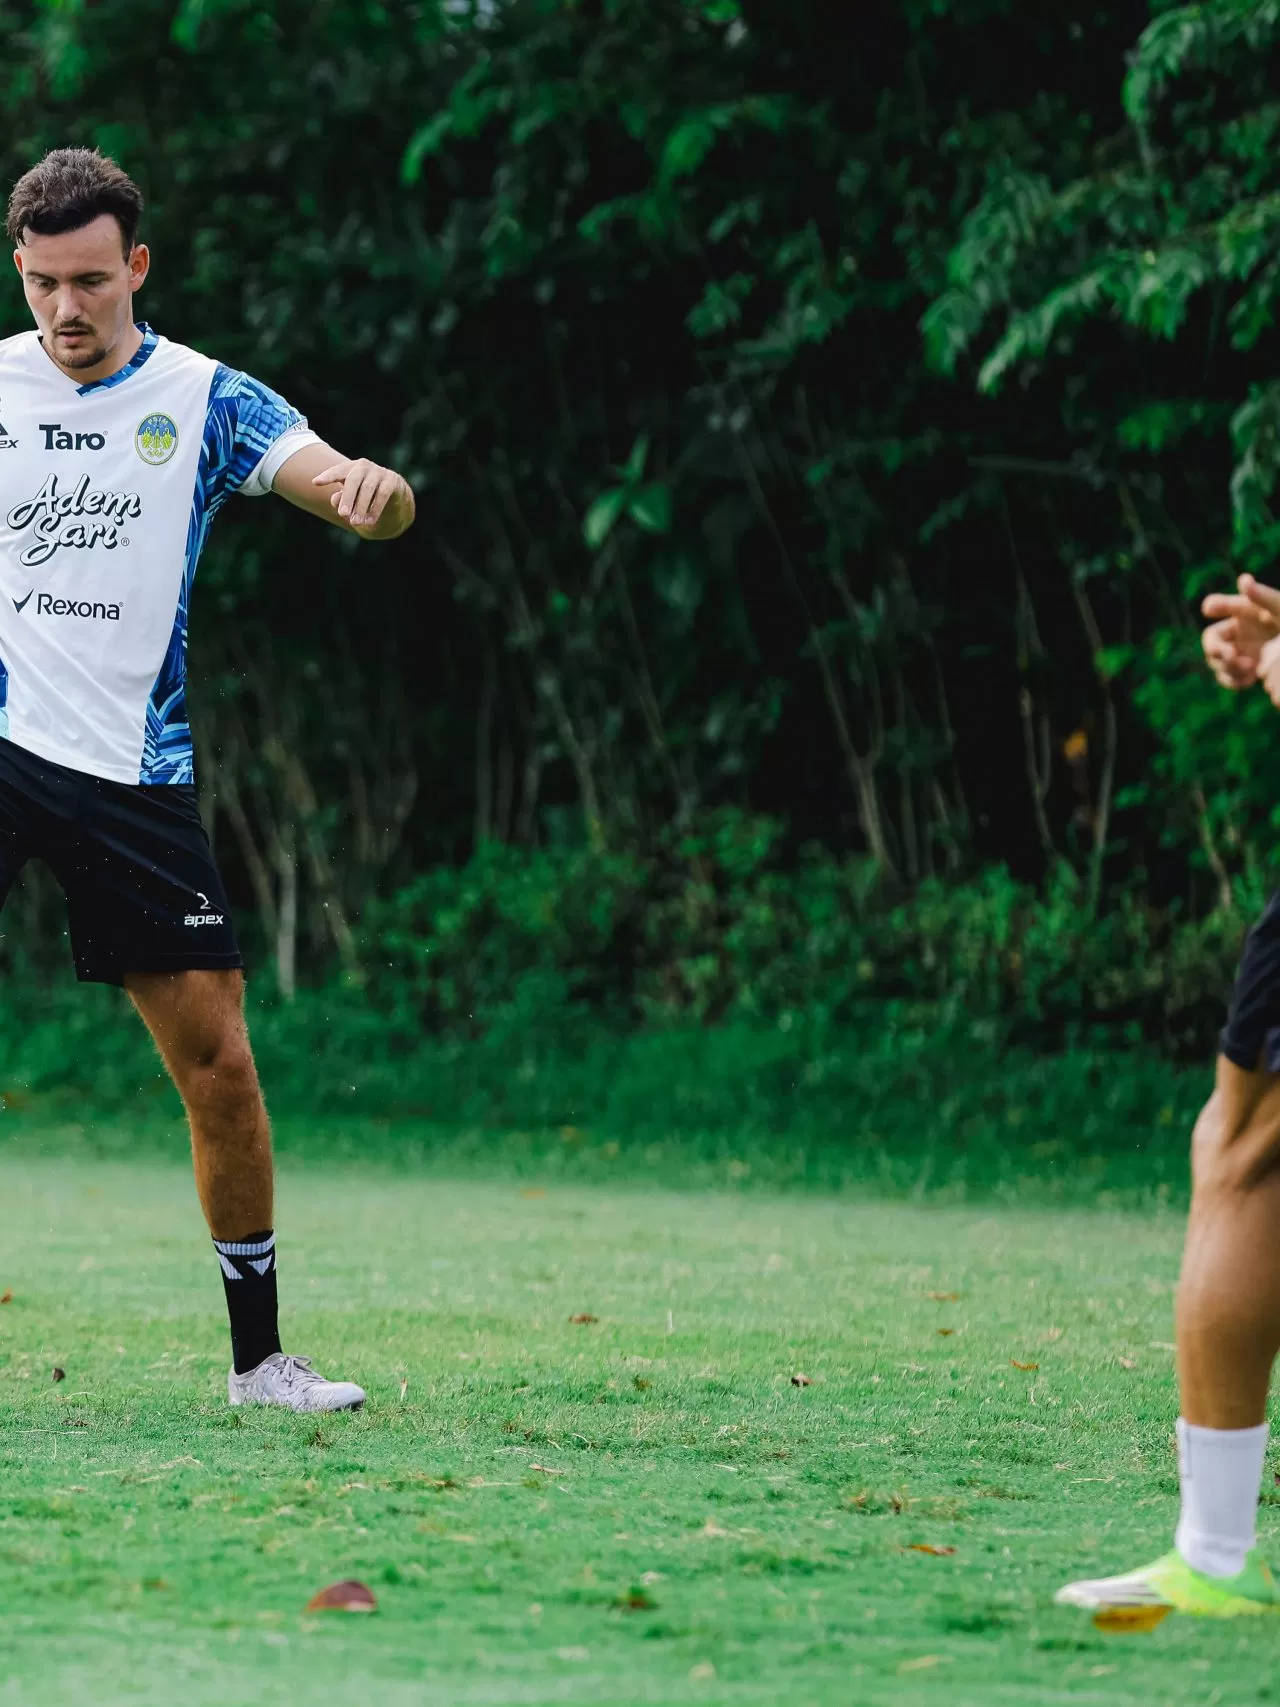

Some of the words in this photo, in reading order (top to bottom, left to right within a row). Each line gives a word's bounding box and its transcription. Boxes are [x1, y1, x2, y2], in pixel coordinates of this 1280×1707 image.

[39, 424, 106, 450] Taro
[7, 472, 141, 530] Adem
[20, 511, 124, 566] Sari
[37, 593, 120, 620] Rexona
[197, 892, 211, 909] 2
[184, 915, 224, 927] apex
